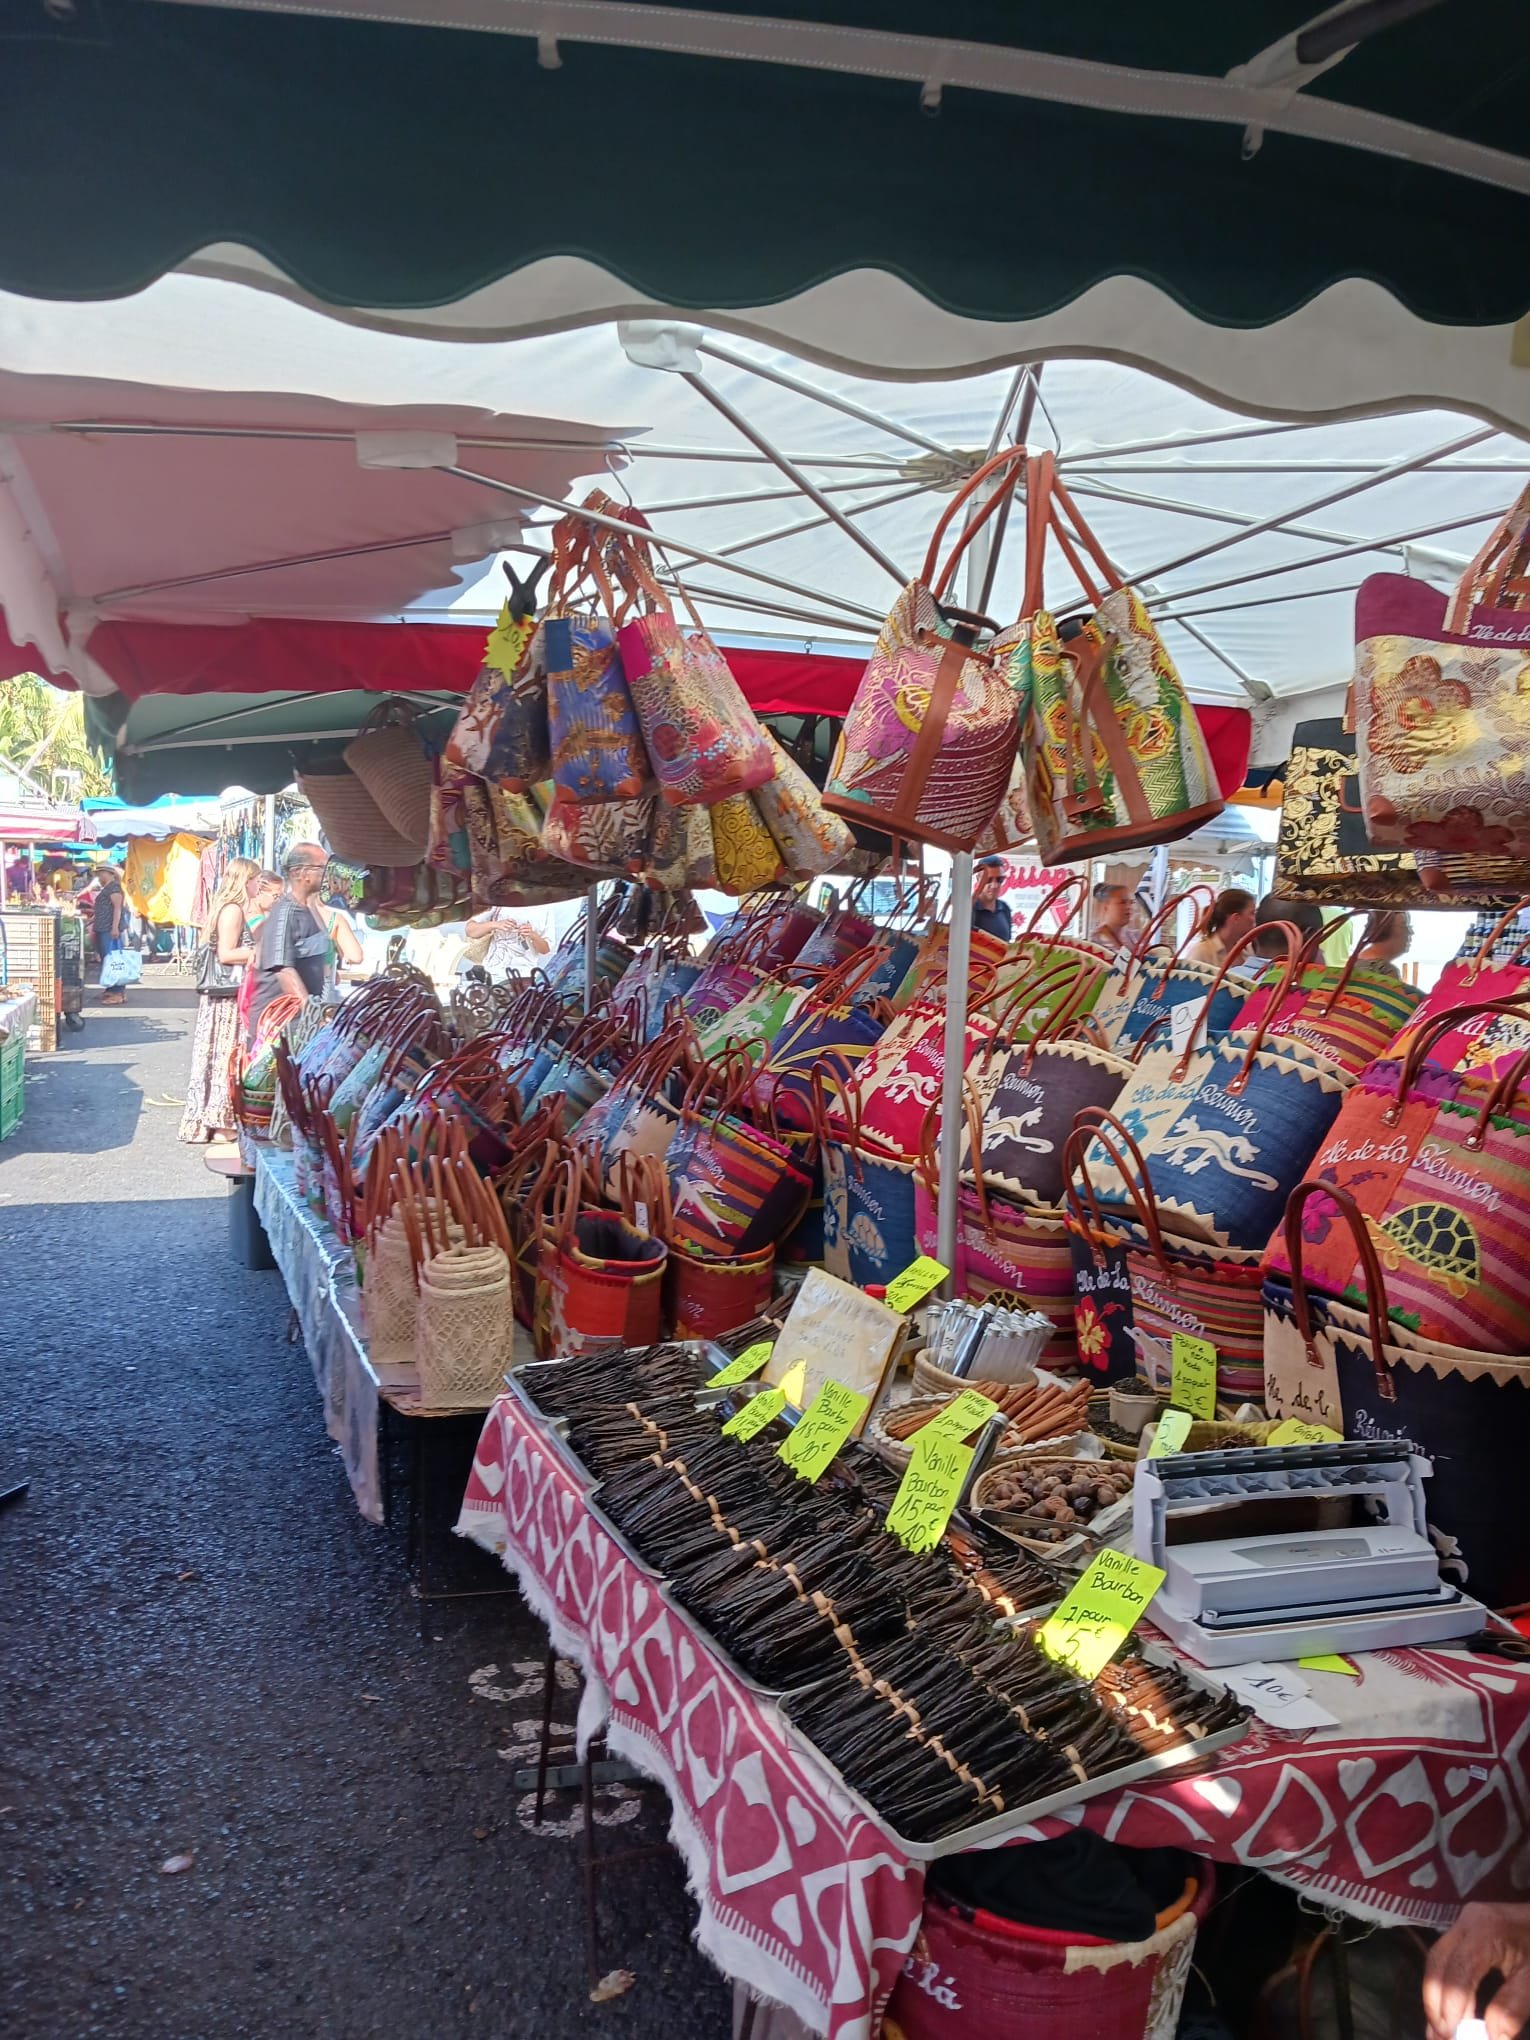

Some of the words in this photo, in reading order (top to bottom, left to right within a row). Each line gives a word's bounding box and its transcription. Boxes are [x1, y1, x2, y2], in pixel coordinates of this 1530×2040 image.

[1347, 1138, 1377, 1162] de
[1411, 1143, 1502, 1213] Réunion
[823, 1380, 854, 1410] Vanille
[921, 1439, 960, 1481] Vanille
[906, 1472, 949, 1498] Bourbon
[894, 1494, 923, 1521] 15
[1098, 1551, 1141, 1576] Vanille
[1090, 1571, 1145, 1605] Bourbon
[1076, 1609, 1112, 1625] pour
[1242, 1675, 1297, 1703] 10€
